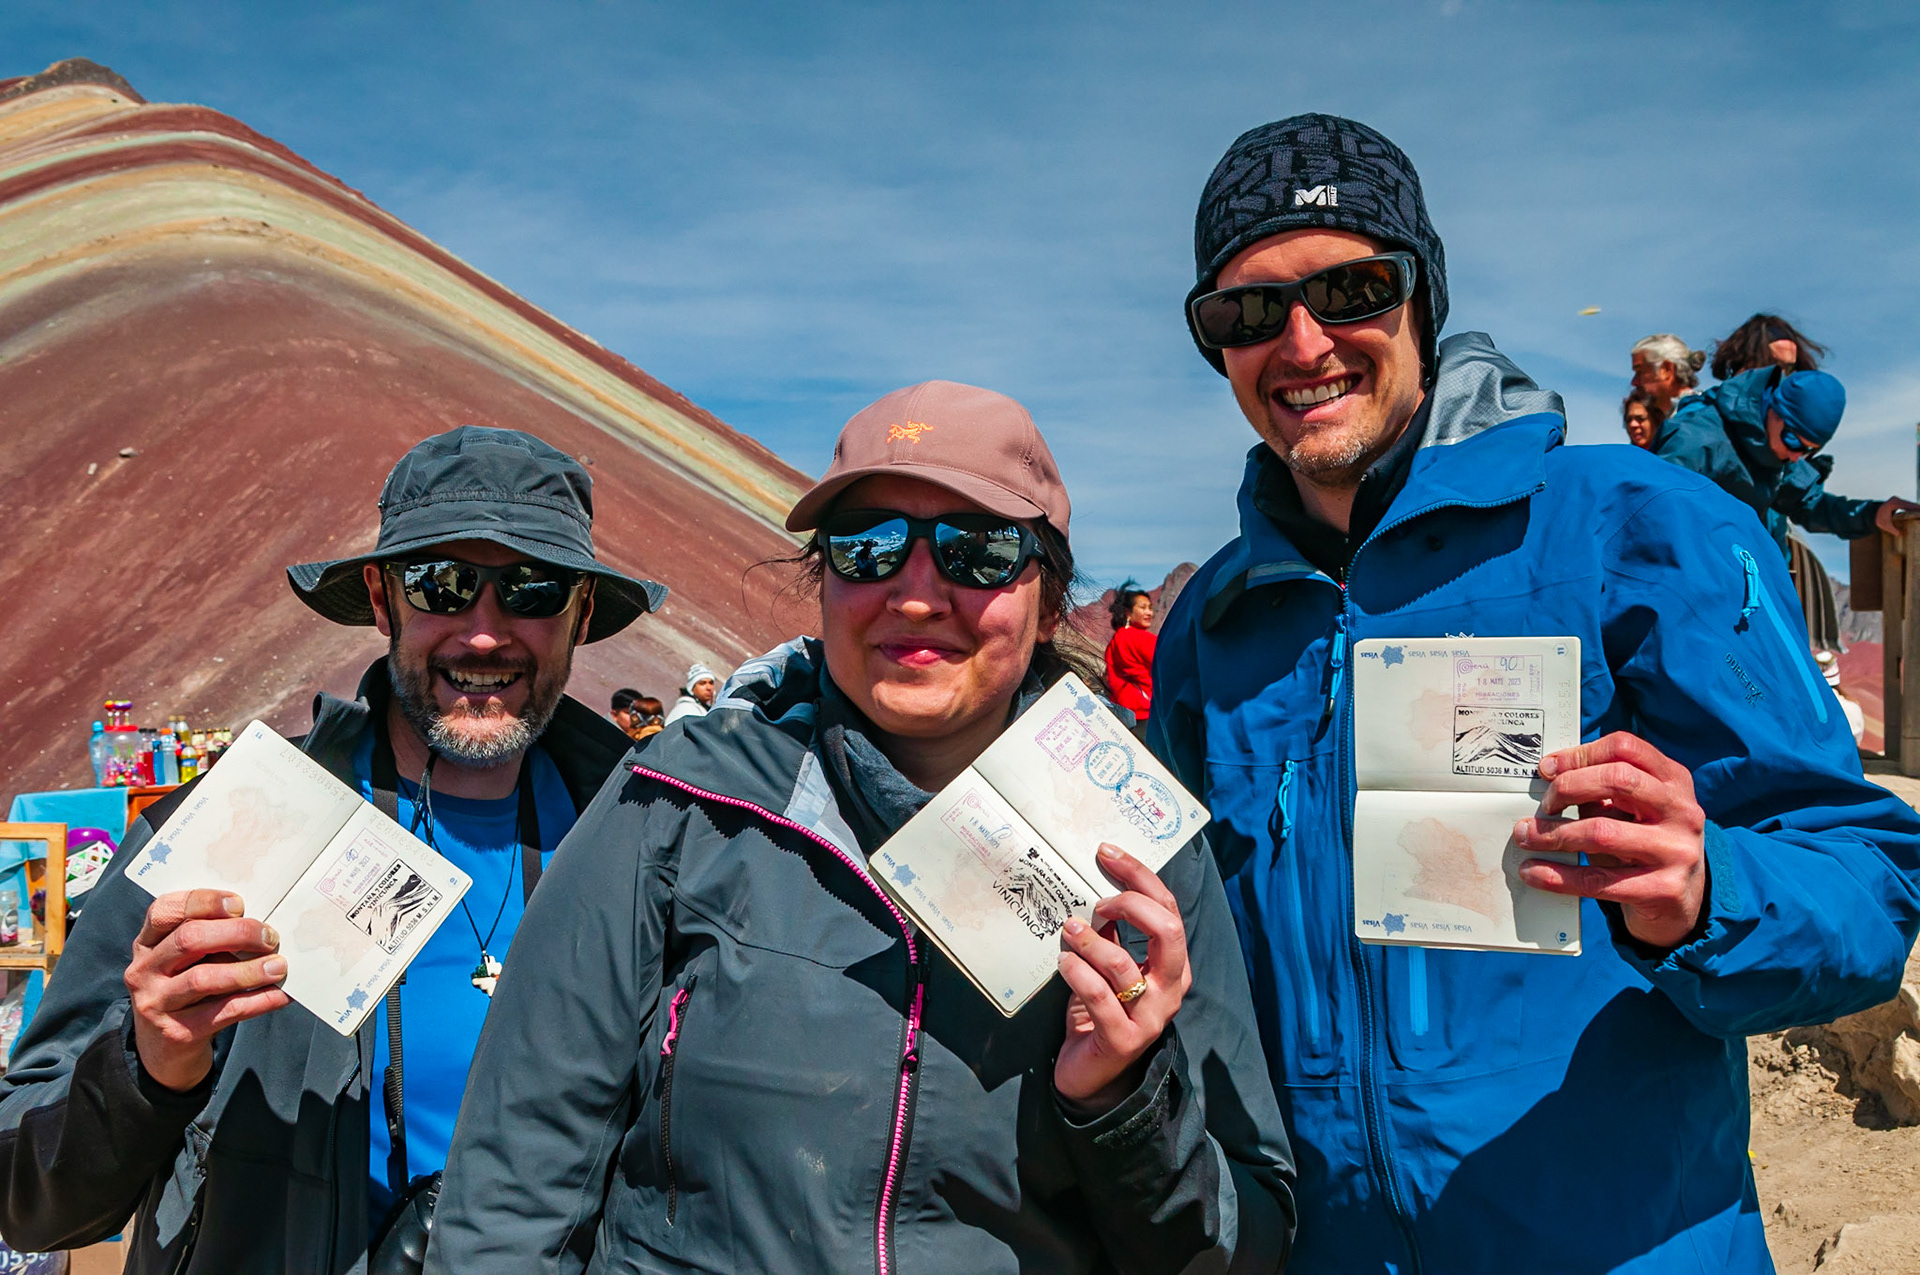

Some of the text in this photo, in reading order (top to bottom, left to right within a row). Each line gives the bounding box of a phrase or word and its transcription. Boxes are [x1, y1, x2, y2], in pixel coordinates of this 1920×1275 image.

[1500, 656, 1517, 671] 90
[1065, 682, 1078, 697] Visas
[1096, 713, 1109, 730] Visas
[1109, 728, 1122, 744] Visas
[1456, 765, 1484, 773] ALTITUD
[1134, 788, 1146, 799] JUL
[166, 797, 209, 842] Visas Visas Visas
[960, 826, 991, 857] MIGRACIONES
[882, 852, 896, 868] Visas
[138, 862, 153, 876] Visas
[1045, 876, 1054, 886] DE
[350, 892, 376, 919] MONTAÑA
[378, 864, 401, 888] COLORES
[367, 878, 398, 909] VINICUNCA
[913, 885, 954, 932] Visas Visas Visas
[993, 881, 1048, 940] VINICUNCA
[1432, 923, 1450, 931] Visas
[1454, 924, 1472, 932] Visas
[388, 930, 408, 951] ALTITUD
[1559, 932, 1567, 941] 10
[365, 974, 380, 988] Visas
